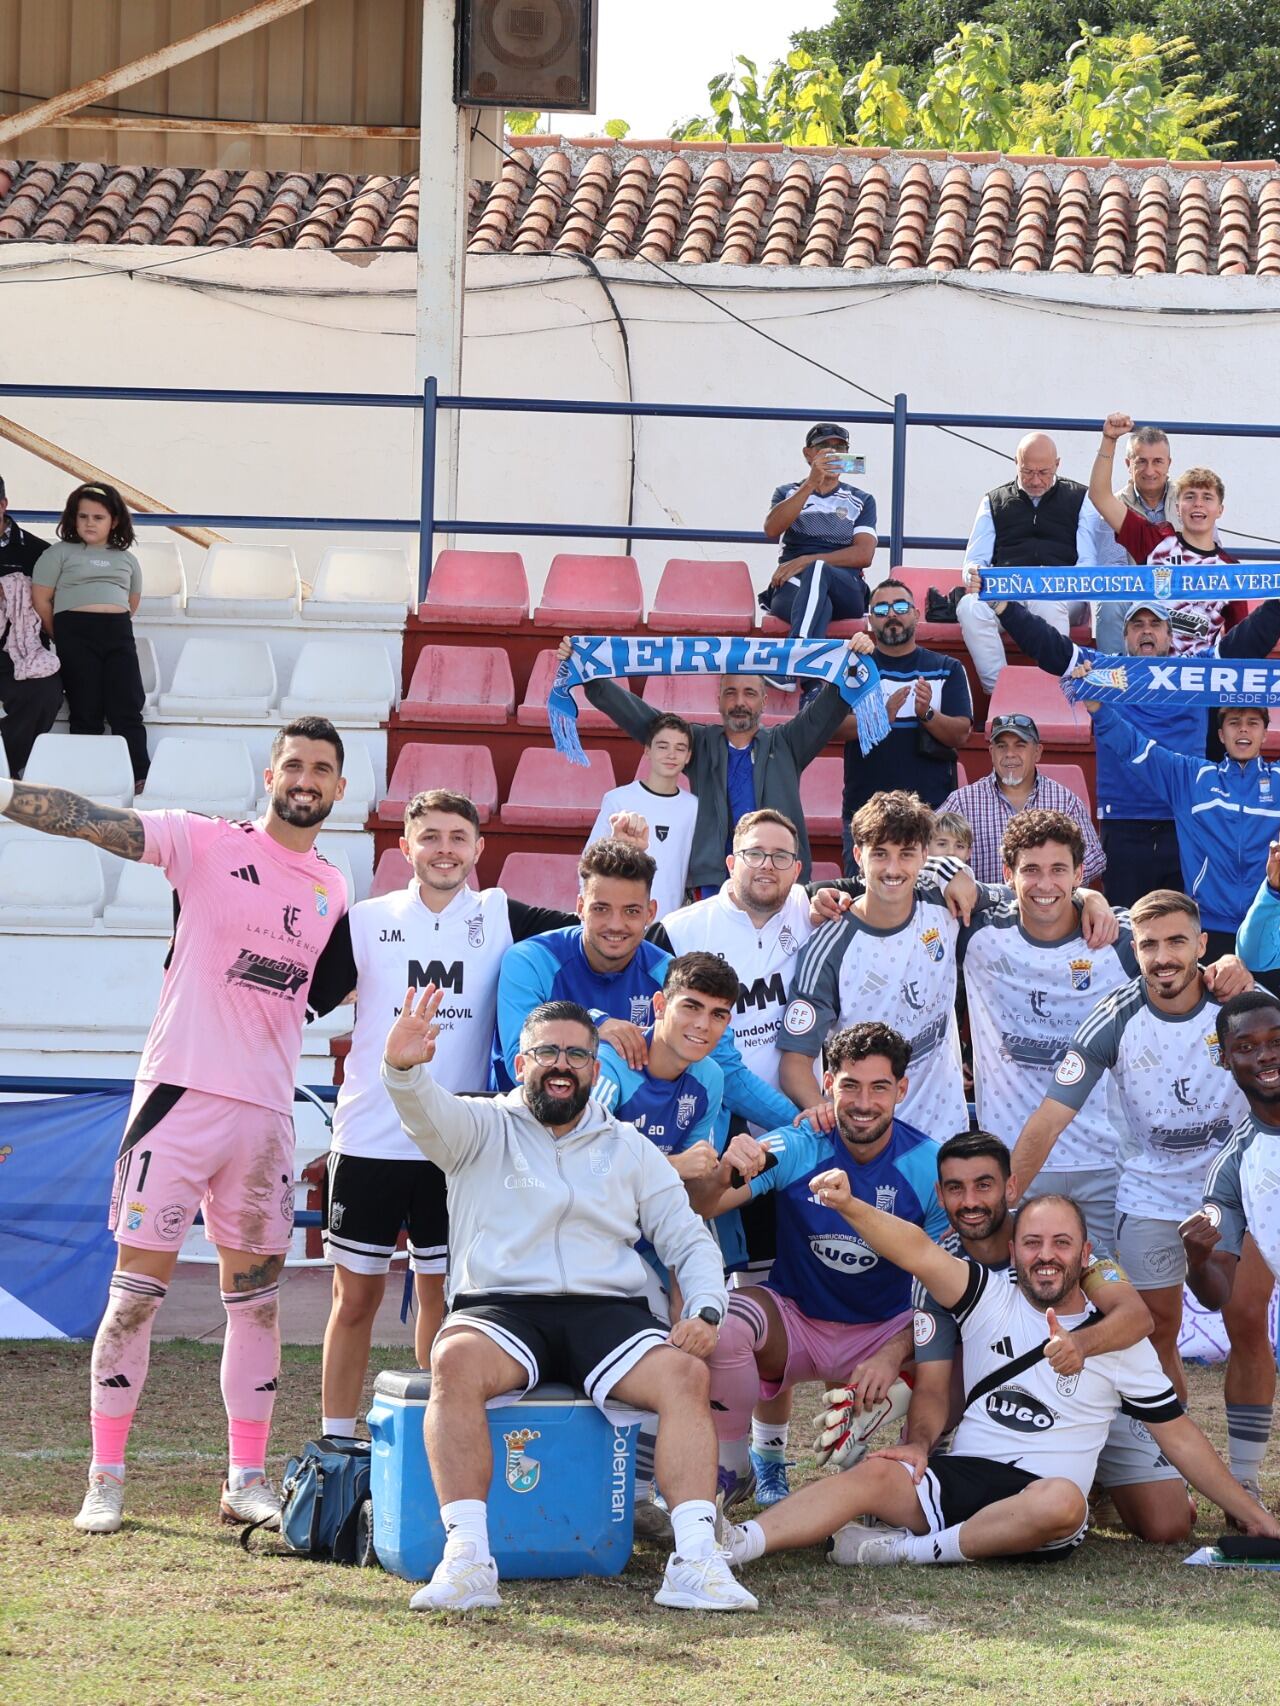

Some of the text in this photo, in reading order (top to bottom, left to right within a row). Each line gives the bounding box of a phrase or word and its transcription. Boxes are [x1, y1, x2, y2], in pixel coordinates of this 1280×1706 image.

[986, 573, 1034, 595] PEÑA
[1040, 575, 1145, 593] XERECISTA
[1182, 574, 1231, 591] RAFA
[571, 636, 844, 679] XEREZ
[1219, 693, 1262, 704] DESDE
[379, 930, 406, 942] J.M.
[238, 948, 309, 979] Torralva
[648, 1125, 665, 1136] 20
[1150, 1119, 1230, 1136] Torralva
[136, 1150, 152, 1193] 1
[813, 1241, 876, 1267] LUGO
[987, 1395, 1052, 1428] LUGO
[612, 1425, 631, 1523] Coleman
